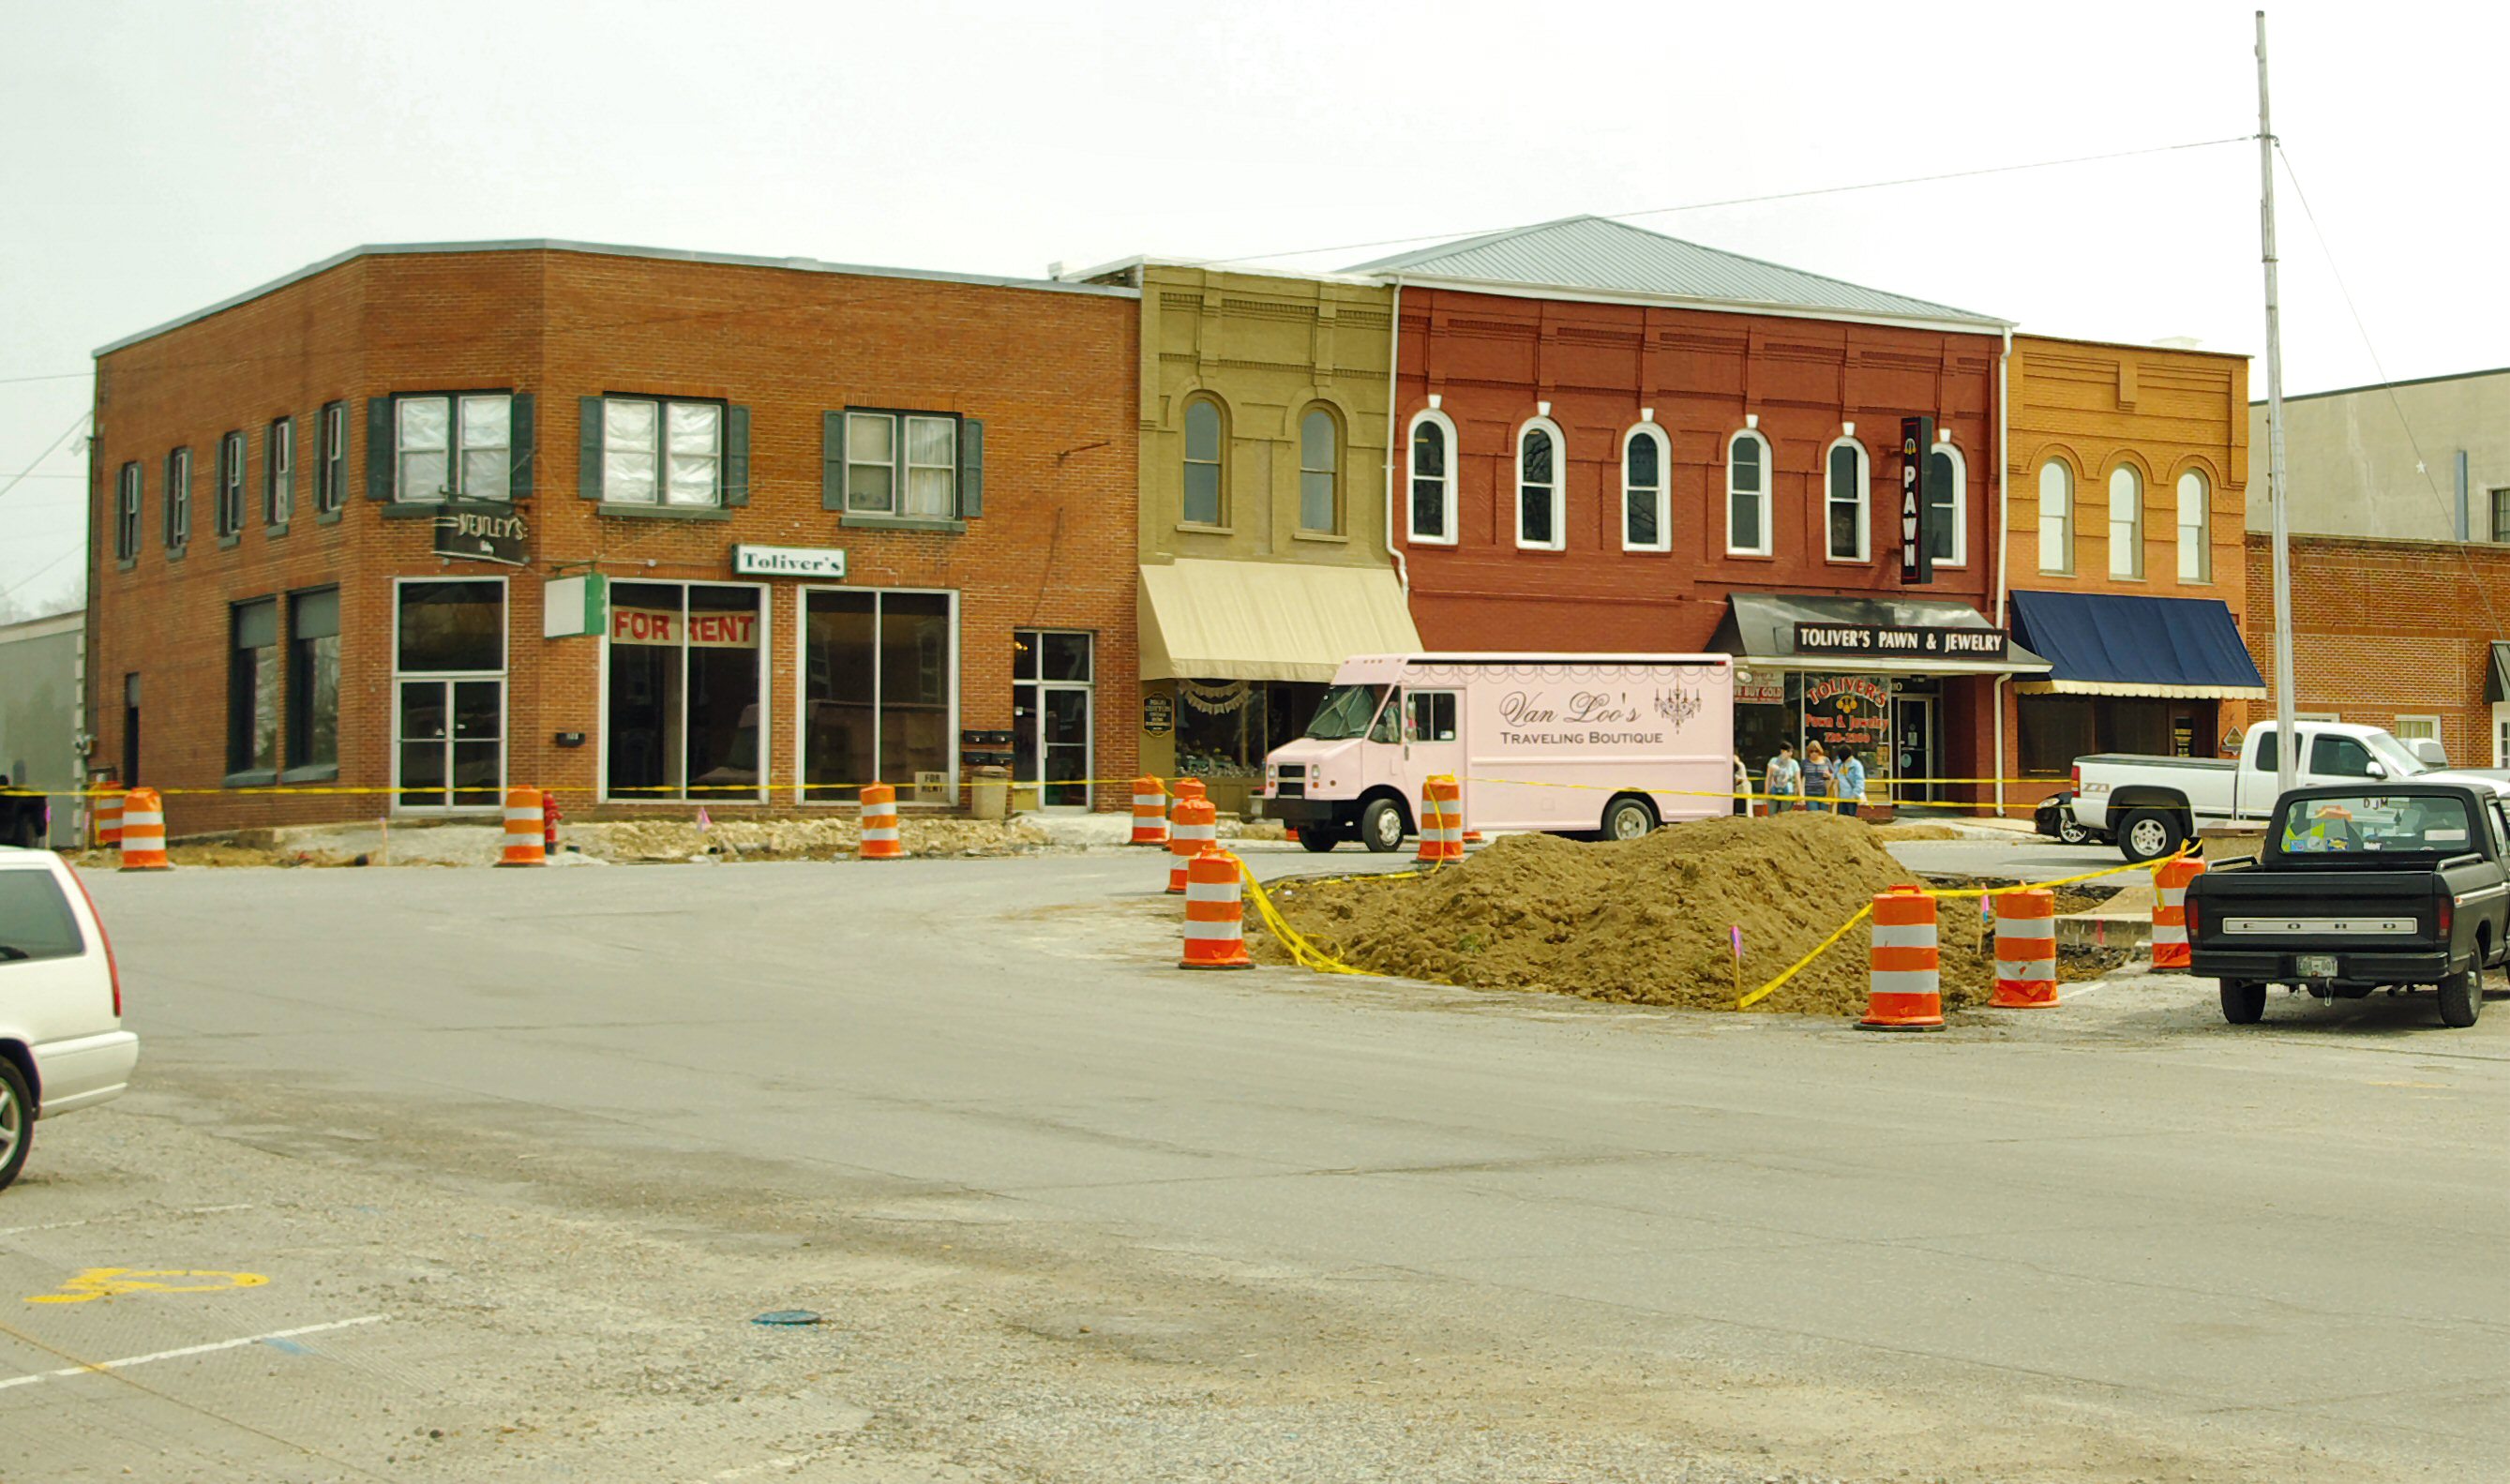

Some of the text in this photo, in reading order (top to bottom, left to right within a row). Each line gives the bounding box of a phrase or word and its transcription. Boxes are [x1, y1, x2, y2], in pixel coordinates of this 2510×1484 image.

[1902, 465, 1917, 567] PAWN
[744, 552, 841, 572] Toliver's
[613, 610, 671, 641] FOR
[1800, 628, 2003, 653] TOLIVER'S PAWN & JEWELRY
[1762, 687, 1782, 698] GOLD
[1806, 677, 1888, 706] TOLIVER'S
[1499, 691, 1642, 727] Van Loo's
[1500, 731, 1663, 744] TRAVELING BOUTIQUE
